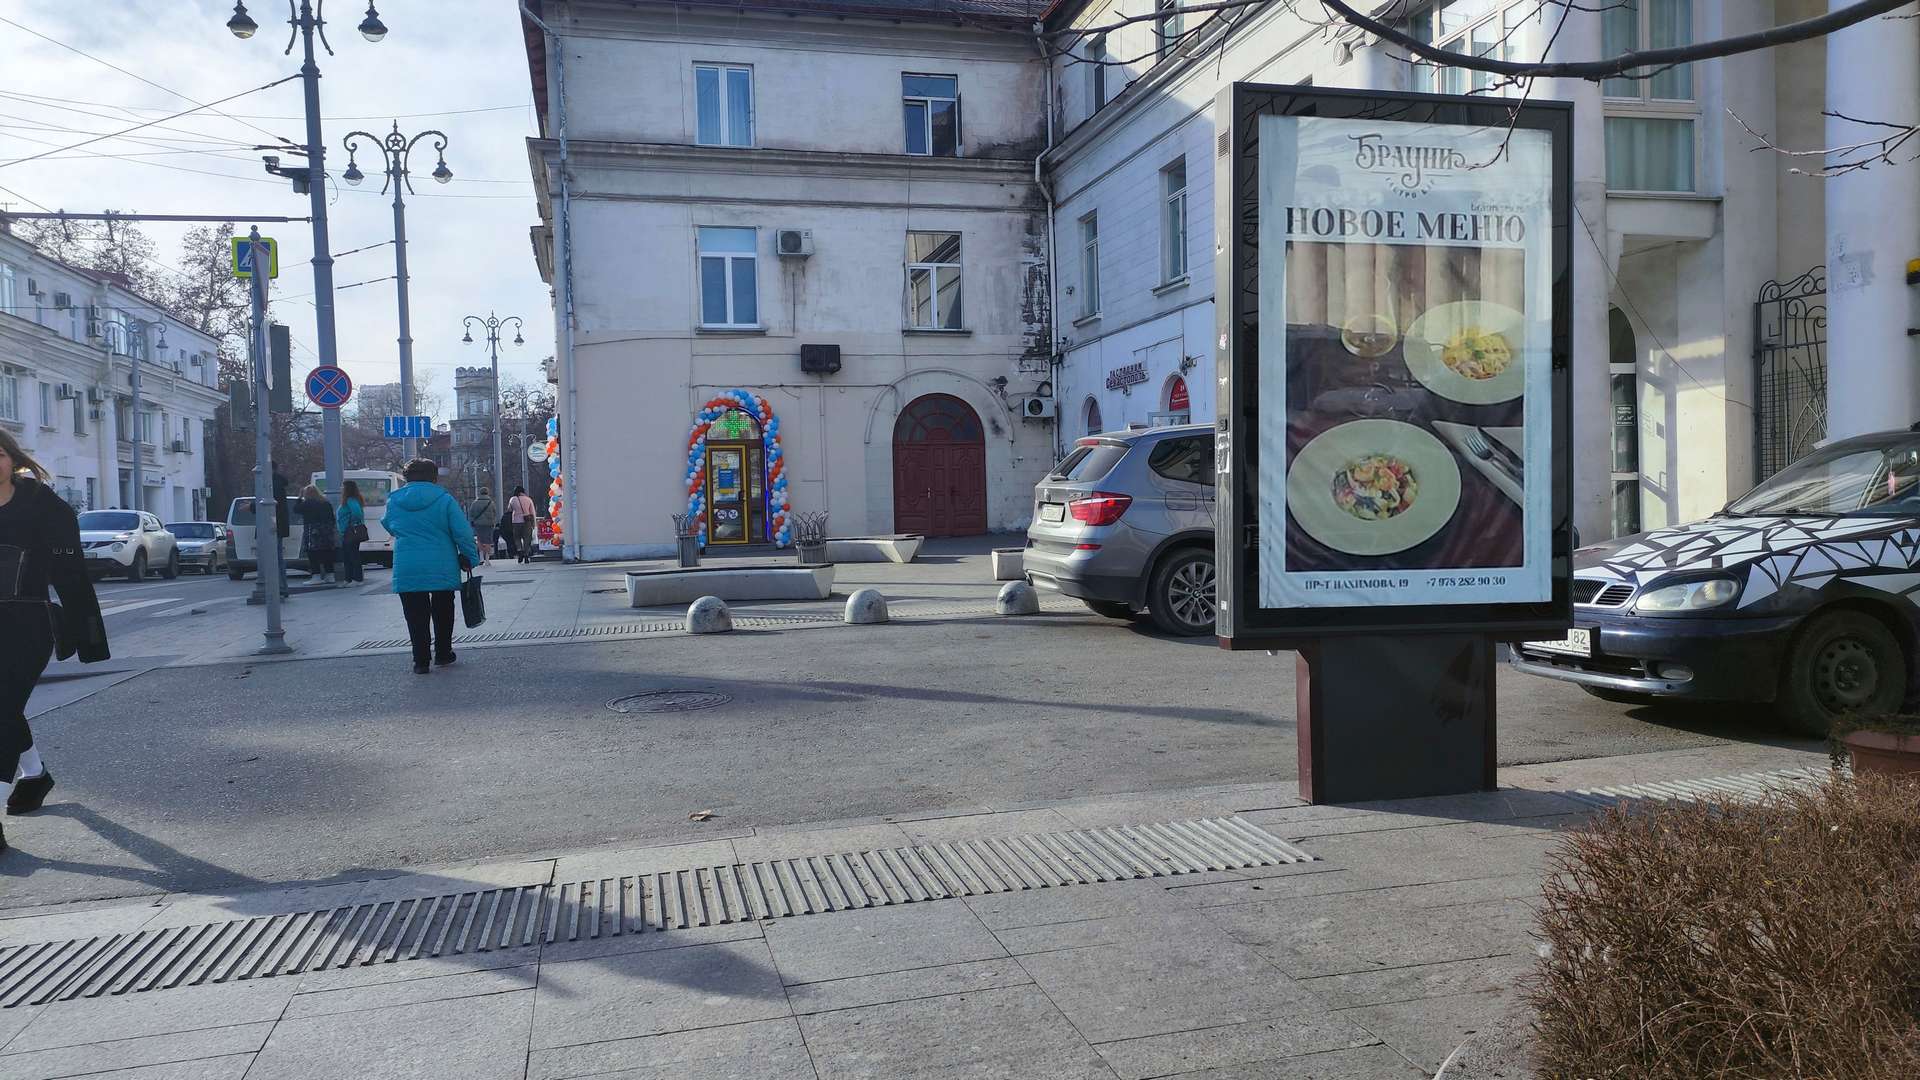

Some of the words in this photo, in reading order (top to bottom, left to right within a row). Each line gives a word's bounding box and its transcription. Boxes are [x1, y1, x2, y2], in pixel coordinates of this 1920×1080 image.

[1285, 207, 1405, 238] НОВОЕ
[1416, 211, 1525, 243] МЕНЮ
[1305, 579, 1331, 590] ПР-Т
[1399, 578, 1409, 588] 19
[1458, 576, 1475, 586] 282
[1477, 576, 1490, 586] 90
[1492, 575, 1506, 585] 30
[1573, 631, 1586, 644] 82
